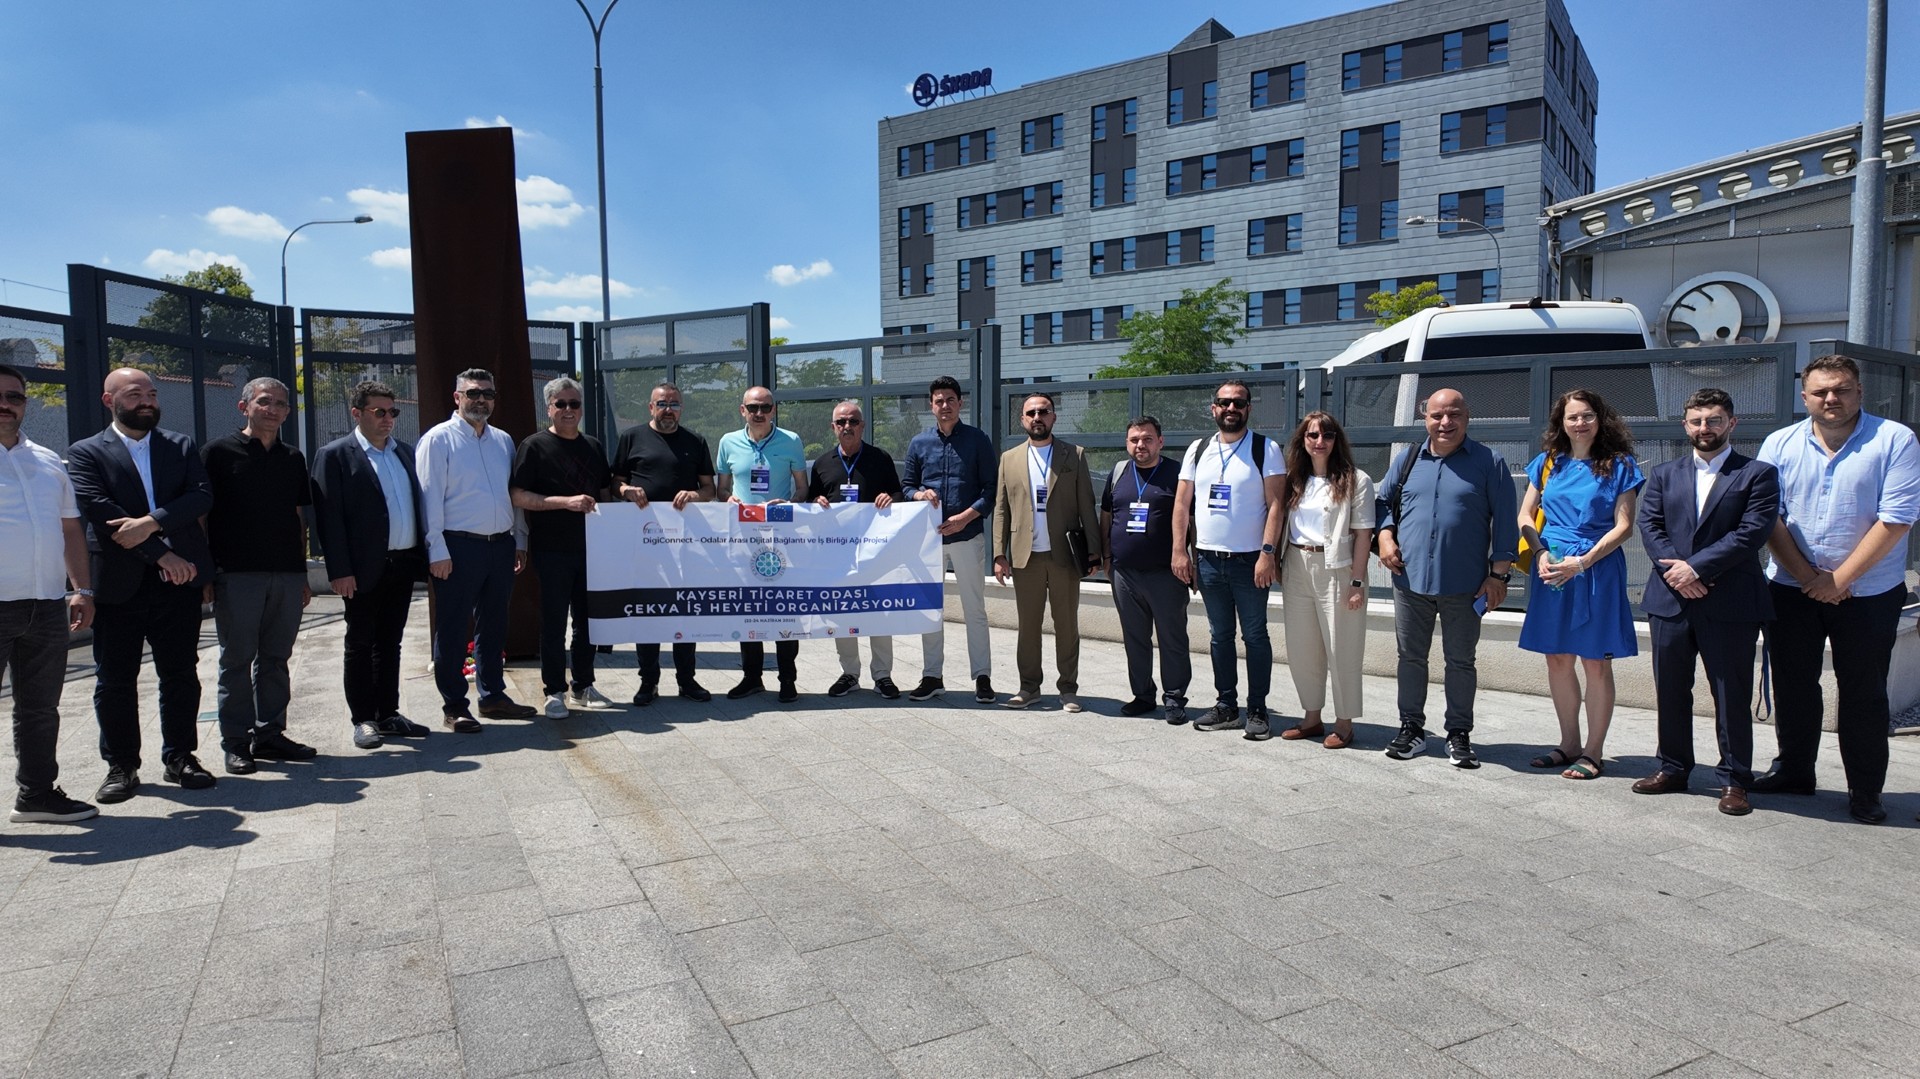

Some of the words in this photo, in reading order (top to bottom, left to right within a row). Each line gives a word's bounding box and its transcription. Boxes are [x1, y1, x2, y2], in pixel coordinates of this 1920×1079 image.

[643, 536, 693, 545] DigiConnect
[700, 536, 727, 544] Odalar
[729, 536, 748, 544] Arası
[750, 536, 772, 545] Dijital
[774, 536, 806, 545] Bağlantı
[826, 536, 848, 545] Birliği
[850, 536, 862, 545] Ağı
[864, 536, 888, 545] Projesi
[676, 587, 743, 601] KAYSERİ
[750, 587, 814, 600] TİCARET
[820, 588, 867, 600] ODASI
[624, 603, 679, 617] ÇEKYA
[687, 600, 702, 616] İŞ
[710, 600, 768, 613] HEYETİ
[775, 598, 915, 613] ORGANİZASYONU
